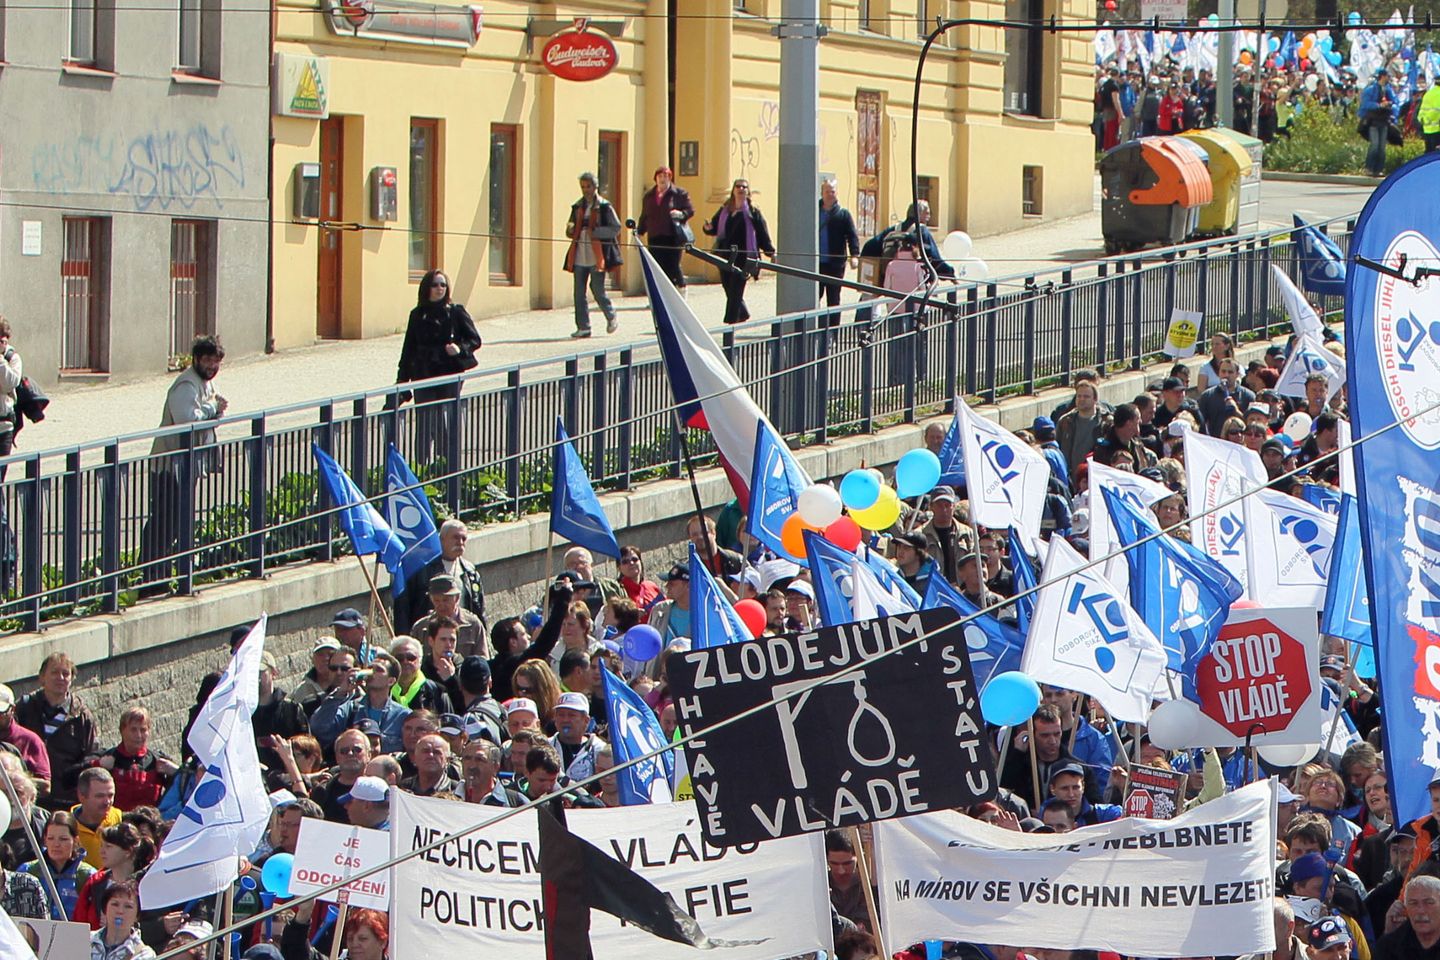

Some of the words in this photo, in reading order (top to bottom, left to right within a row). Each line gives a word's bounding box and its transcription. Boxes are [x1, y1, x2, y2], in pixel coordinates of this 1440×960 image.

[1382, 315, 1396, 370] DIESEL
[1390, 374, 1417, 429] BOSCH
[1207, 512, 1218, 556] DIESEL
[685, 613, 928, 690] ZLODEJŮM
[1211, 632, 1283, 684] STOP
[1217, 674, 1292, 725] VLÁDĚ
[752, 755, 929, 840] VLÁDĚ
[1131, 795, 1148, 811] STOP
[334, 853, 362, 869] ČAS
[342, 837, 361, 850] JE
[296, 868, 387, 897] ODCHÁZENÍ
[894, 879, 911, 902] NA
[914, 875, 979, 902] MÍROV
[983, 879, 1011, 902] SE
[1020, 877, 1130, 907] VŠICHNI
[1140, 877, 1272, 908] NEVLEZETE
